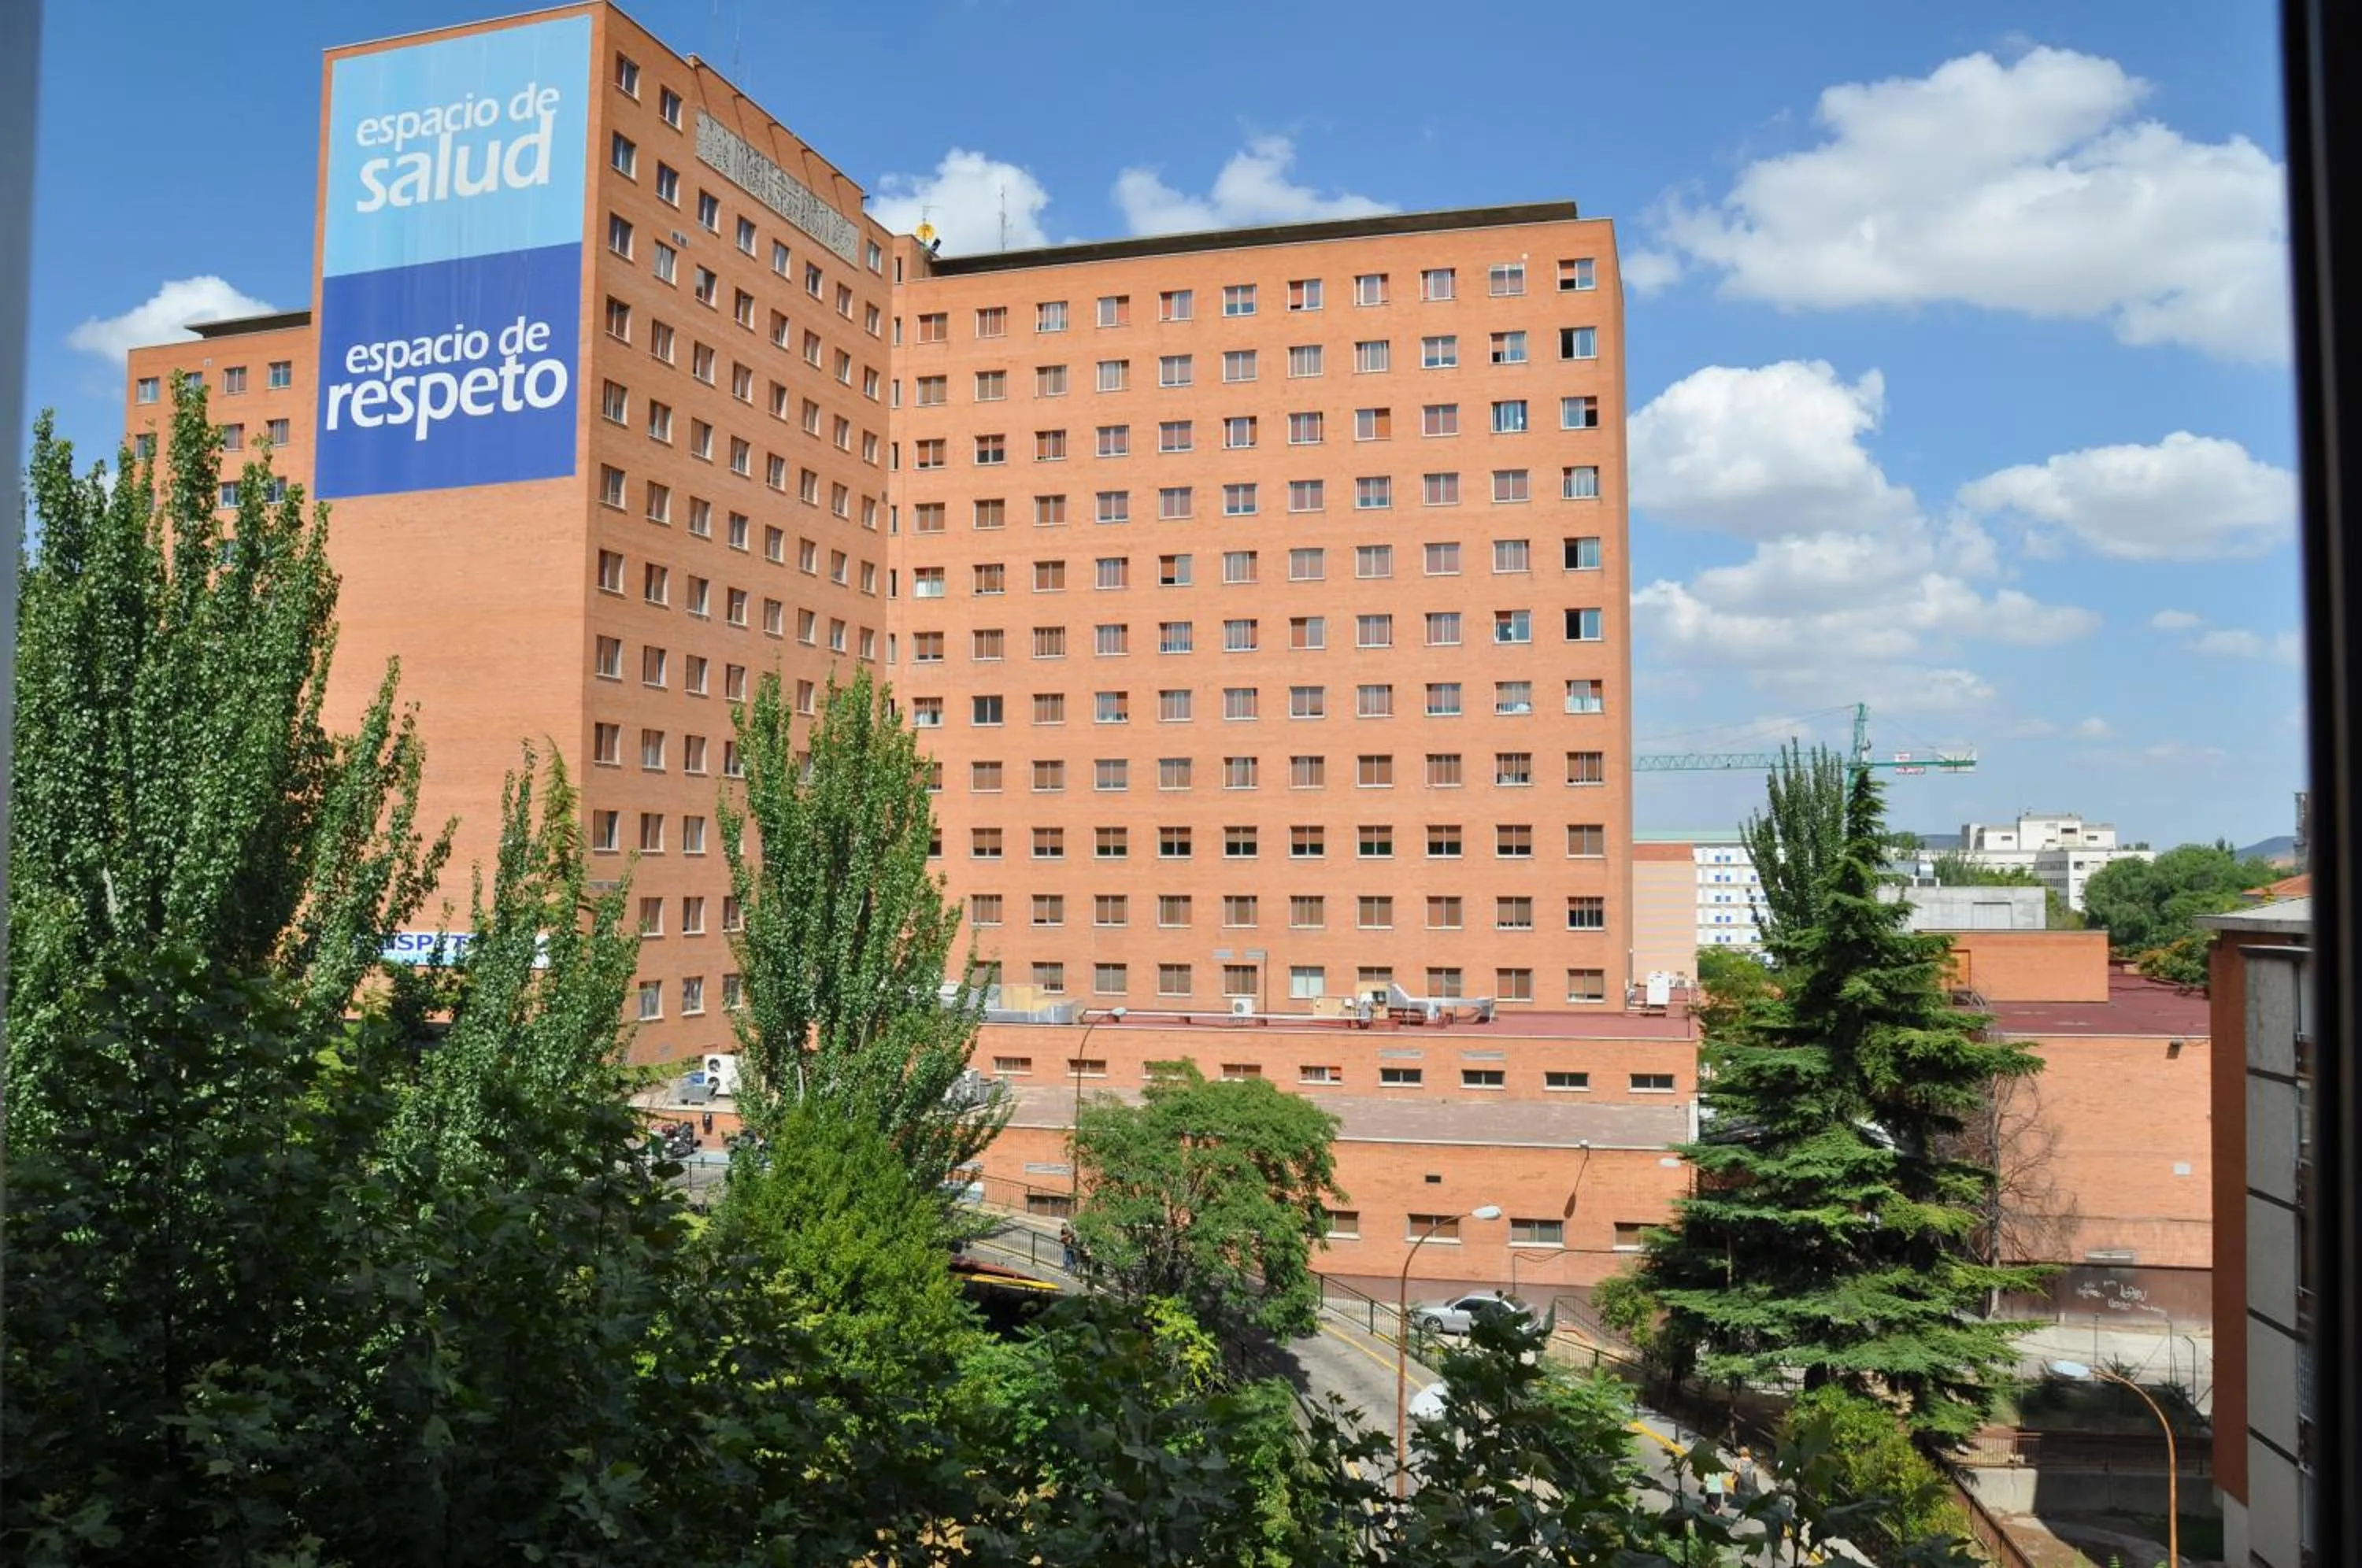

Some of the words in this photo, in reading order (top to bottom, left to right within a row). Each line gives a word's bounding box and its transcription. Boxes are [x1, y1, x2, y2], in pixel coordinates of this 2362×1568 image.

[357, 93, 499, 152] espacio
[509, 82, 560, 120] de
[356, 112, 553, 213] salud
[346, 324, 489, 381] espacio
[498, 316, 550, 356] de
[326, 353, 568, 441] respeto
